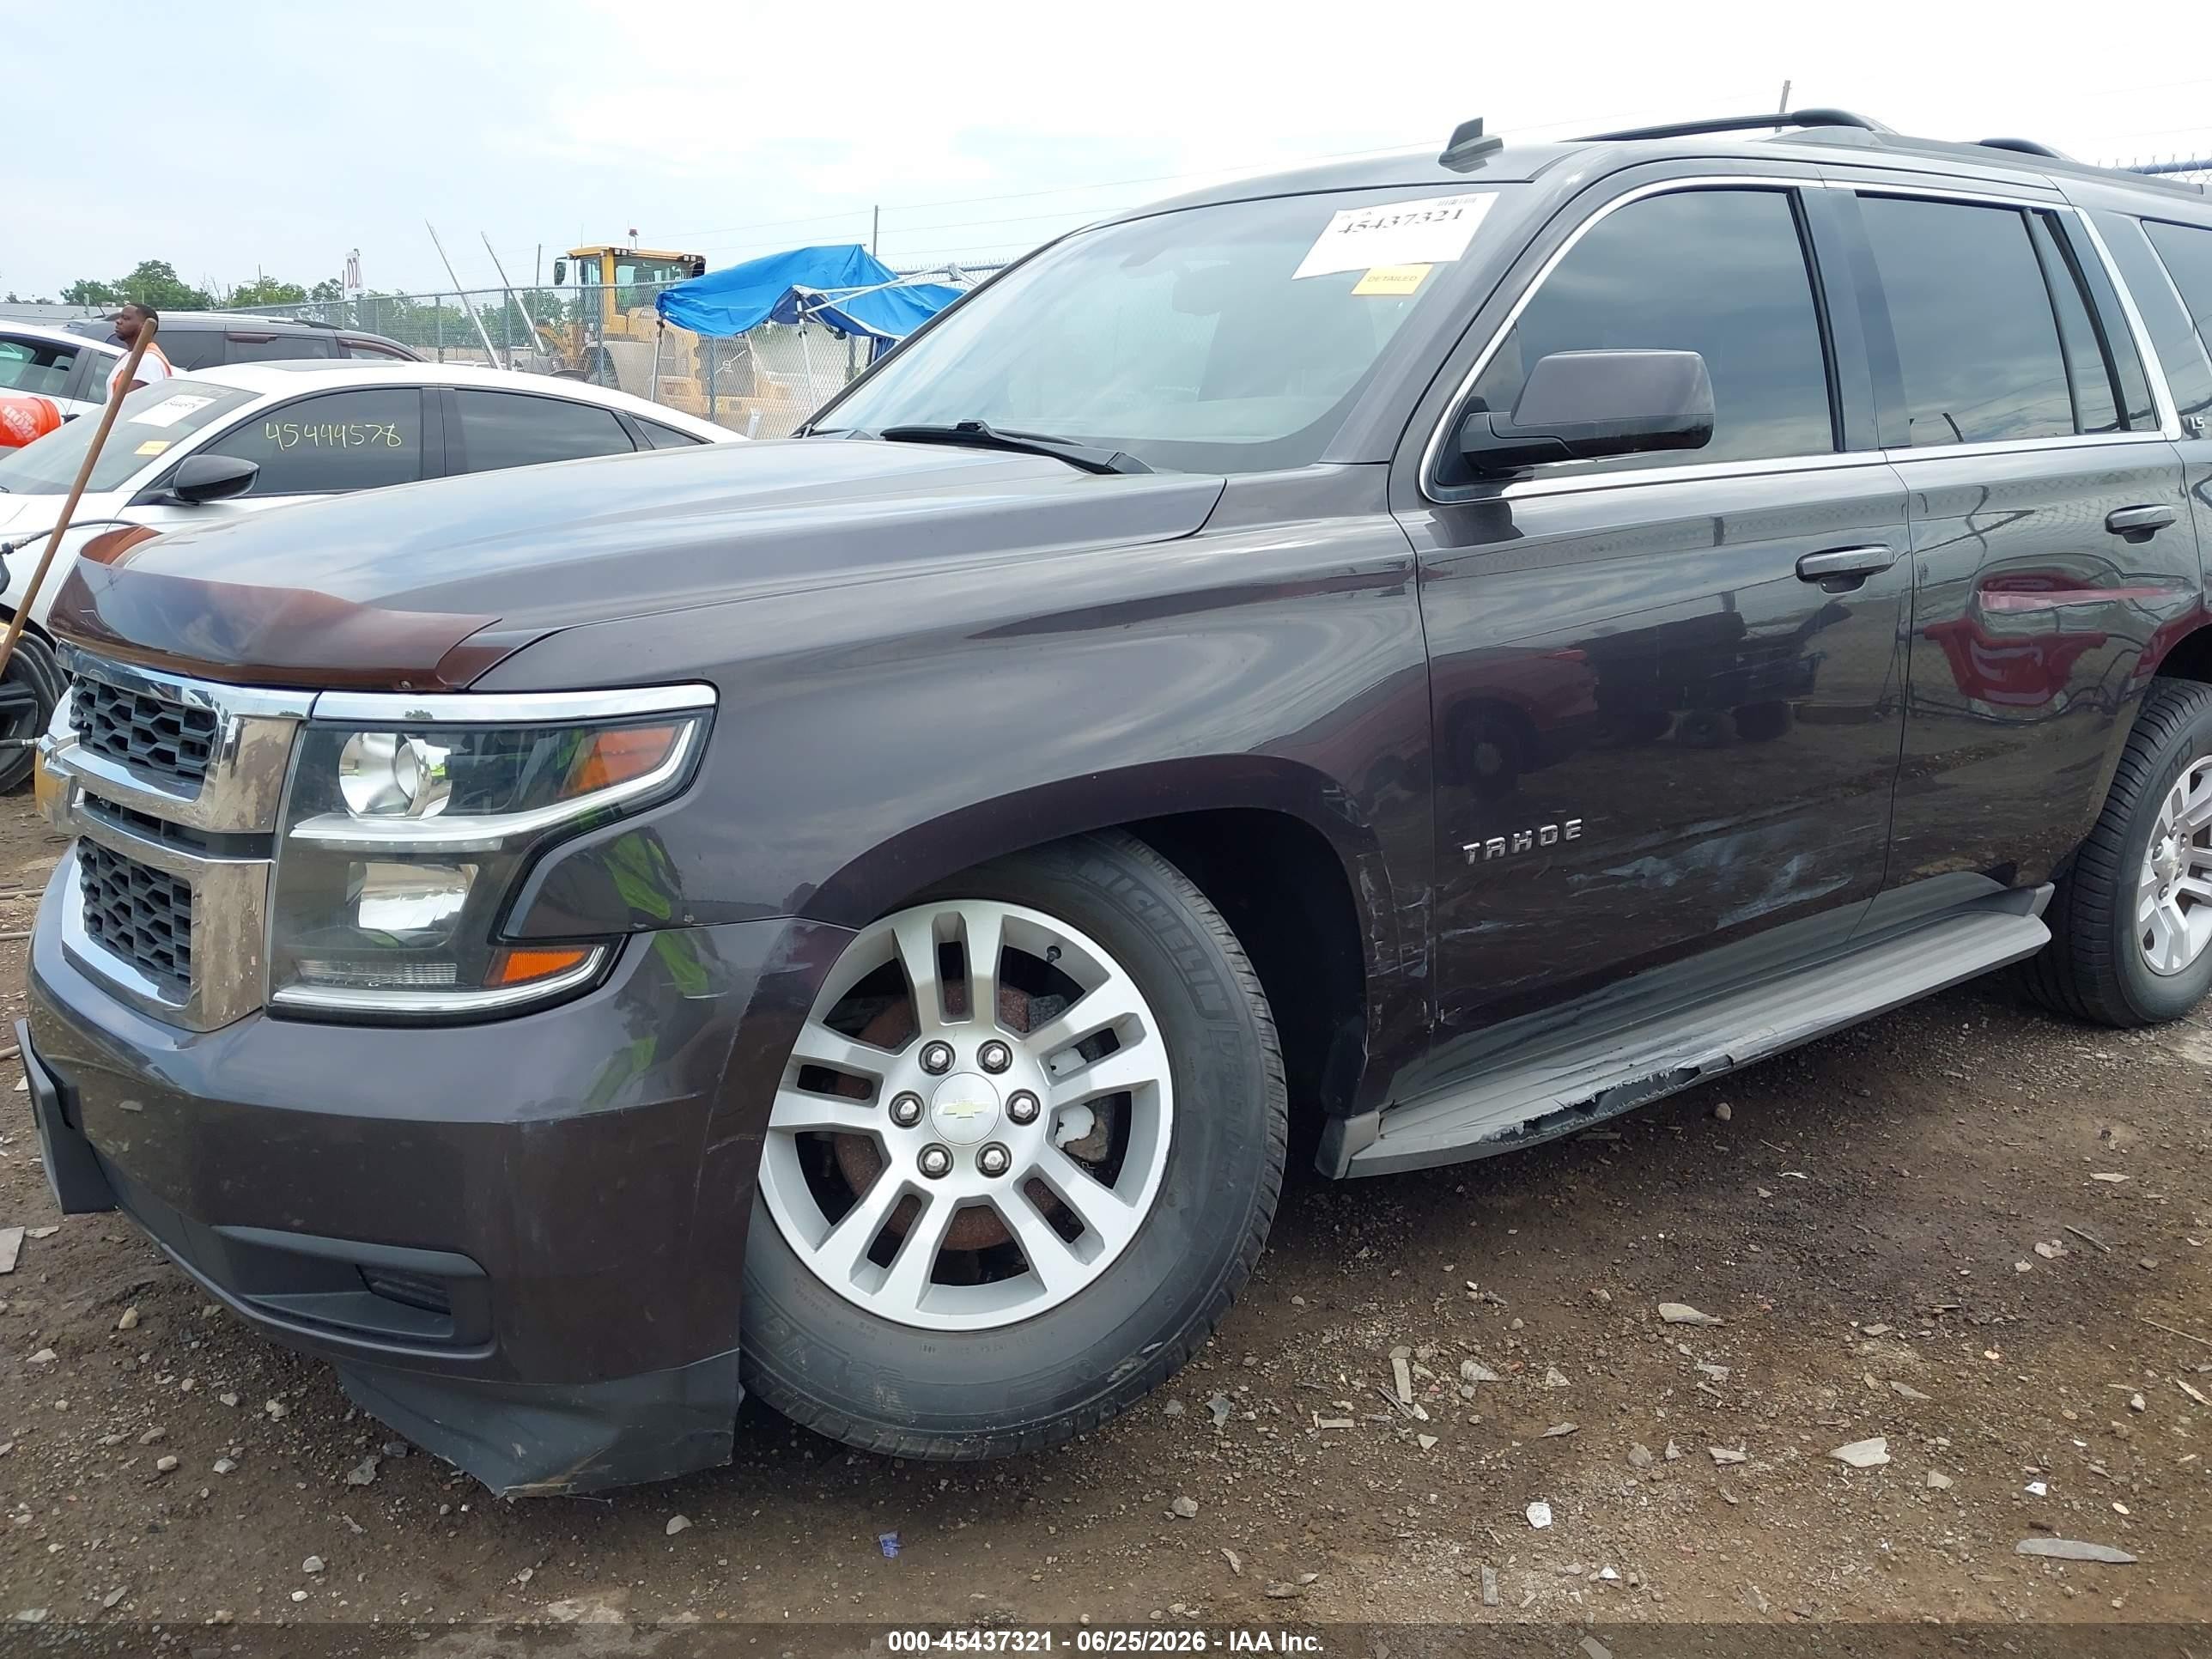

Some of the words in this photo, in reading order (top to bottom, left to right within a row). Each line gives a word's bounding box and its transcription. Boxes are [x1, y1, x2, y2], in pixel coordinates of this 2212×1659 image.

[1339, 208, 1463, 234] 45437321
[1367, 274, 1417, 283] DETAILED
[2190, 416, 2206, 429] LS
[264, 422, 402, 452] 45444578
[1462, 818, 1583, 865] TAHOE
[1079, 859, 1230, 1012] MICHELIN
